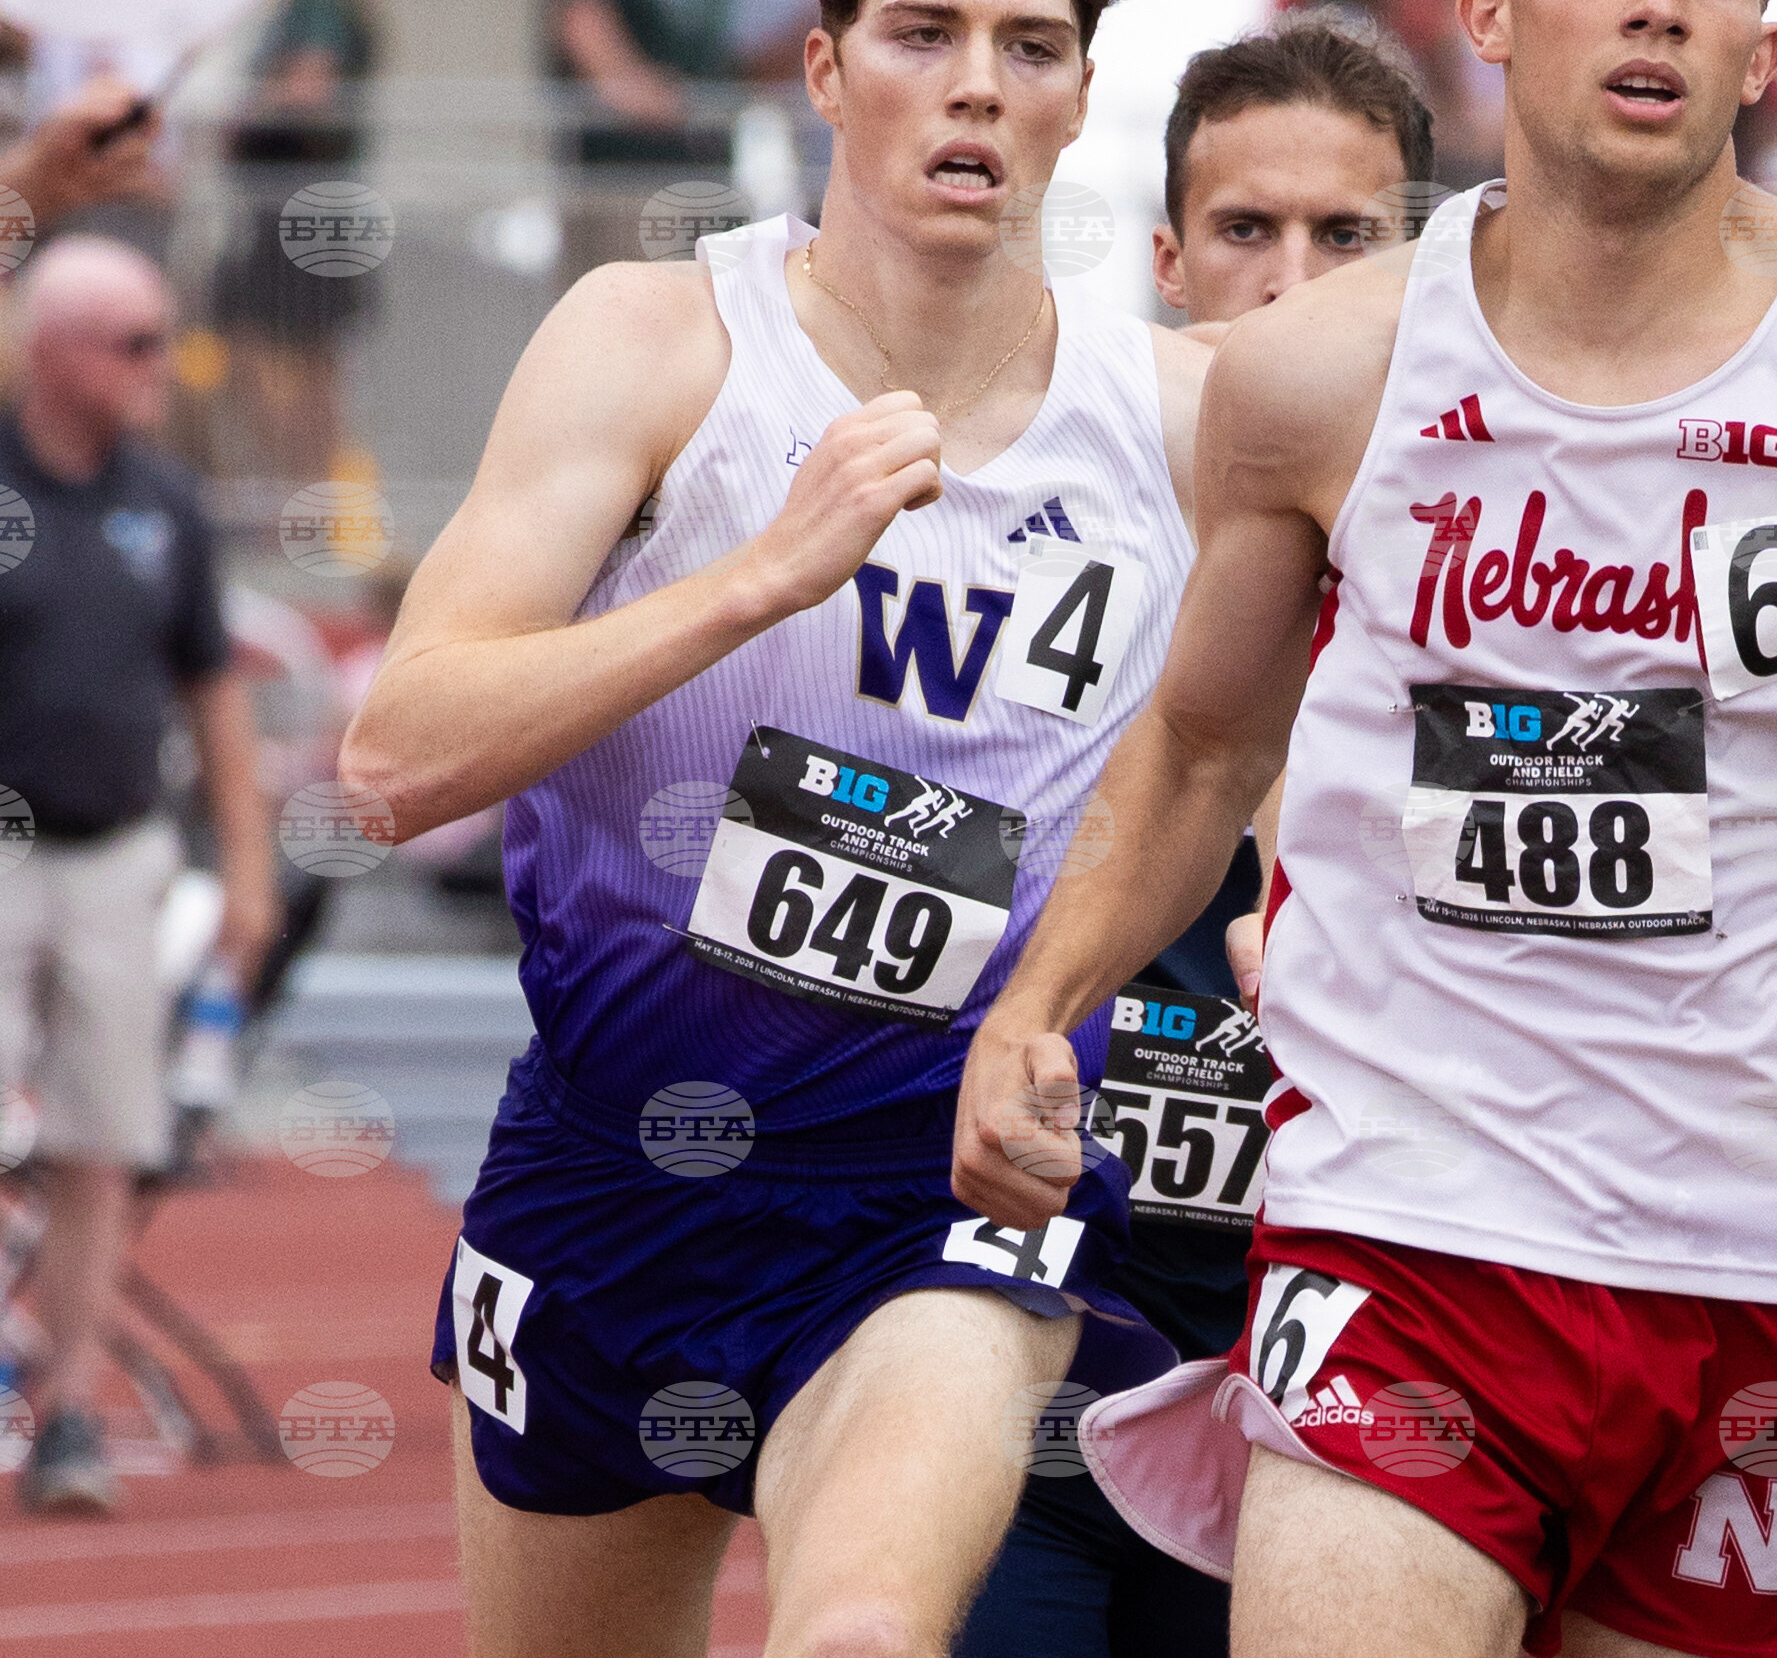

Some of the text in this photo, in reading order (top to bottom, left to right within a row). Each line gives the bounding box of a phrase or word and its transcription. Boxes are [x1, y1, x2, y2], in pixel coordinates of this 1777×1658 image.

[1408, 488, 1709, 678] Nebrask
[852, 557, 1015, 727] W
[1026, 559, 1115, 713] 4
[1489, 754, 1604, 766] OUTDOOR TRACK
[1512, 767, 1584, 778] AND FIELD
[1505, 778, 1592, 787] CHAMPIONSHIPS
[821, 813, 930, 857] OUTDOOR TRACK
[840, 832, 909, 862] AND FIELD
[829, 840, 913, 873] CHAMPIONSHIPS
[1455, 799, 1654, 909] 488
[747, 849, 953, 994] 649
[1526, 917, 1571, 929] NEBRASKA
[1578, 920, 1626, 930] NEBRASKA
[1628, 918, 1673, 929] OUTDOOR
[694, 939, 712, 952] MAY
[798, 979, 842, 1000] NEBRASKA
[847, 995, 887, 1010] NEBRASKA
[888, 1004, 926, 1018] OUTDOOR
[927, 1010, 950, 1022] TRACK
[1134, 1047, 1245, 1073] OUTDOOR TRACK
[1155, 1062, 1224, 1081] AND FIELD
[1146, 1071, 1230, 1091] CHAMPIONSHIPS
[1092, 1087, 1273, 1205] 557
[1134, 1204, 1255, 1227] NEBRASKA NEBRASKA OUTD
[467, 1271, 514, 1416] 4
[1258, 1271, 1341, 1407] 6
[1291, 1405, 1375, 1428] adidas
